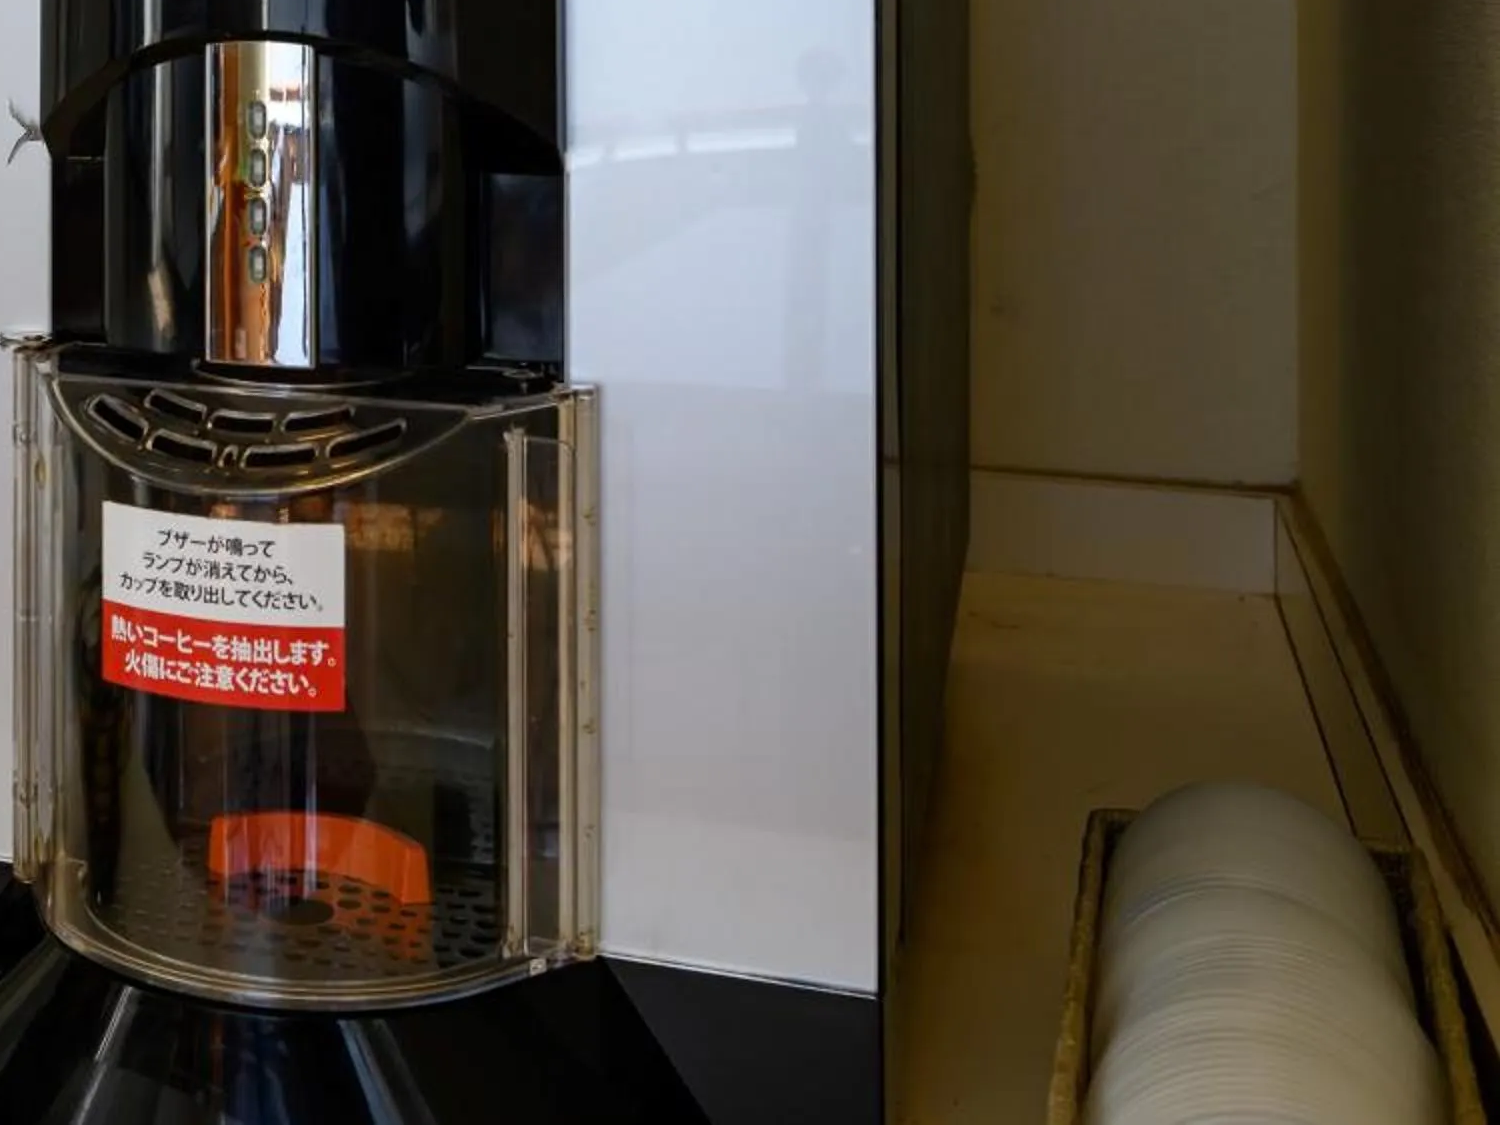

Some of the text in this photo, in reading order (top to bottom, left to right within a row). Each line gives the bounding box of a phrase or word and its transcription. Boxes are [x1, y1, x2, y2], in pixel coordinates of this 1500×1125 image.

[157, 528, 276, 558] ブザーが鳴って
[142, 551, 295, 586] ランプが消えてから、
[119, 573, 323, 612] カップを取り出してください。
[111, 614, 336, 668] 熱いコーヒーを抽出します。
[124, 649, 317, 697] 火傷にご注意ください。
